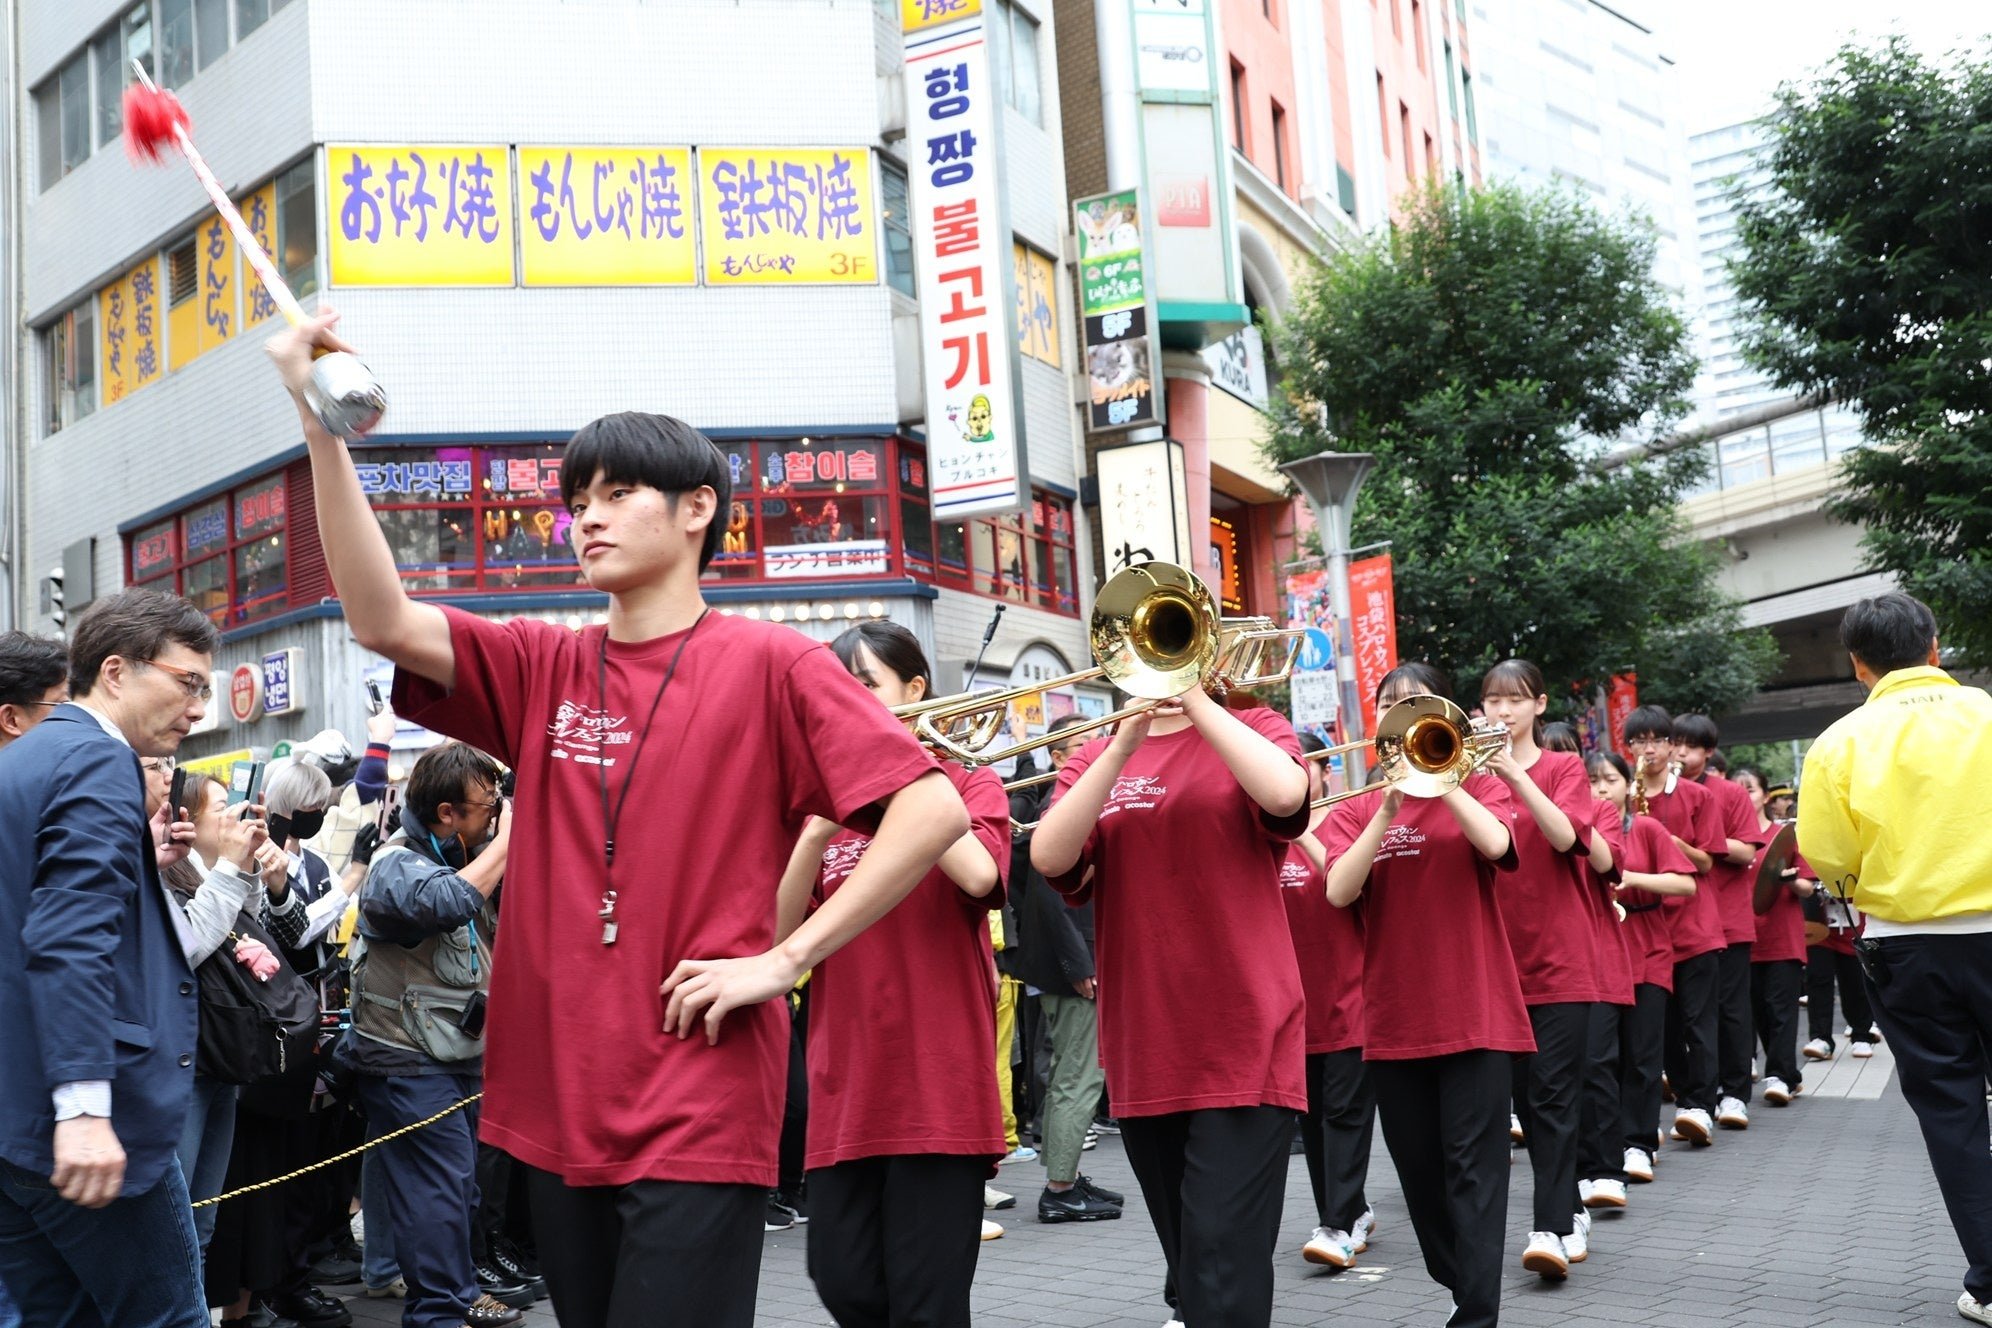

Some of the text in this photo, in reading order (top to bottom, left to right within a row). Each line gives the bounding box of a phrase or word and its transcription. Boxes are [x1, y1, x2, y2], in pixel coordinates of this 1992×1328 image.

[925, 62, 977, 188] 형짱
[341, 152, 499, 244] お好焼
[531, 152, 684, 242] もんじゃ焼
[712, 152, 862, 241] 鉄板焼
[829, 253, 867, 276] 3F
[933, 198, 991, 390] 불고기
[111, 381, 124, 401] 3F
[1108, 398, 1138, 425] 5F
[784, 450, 877, 482] 참이슬
[1899, 693, 1945, 706] STAFF
